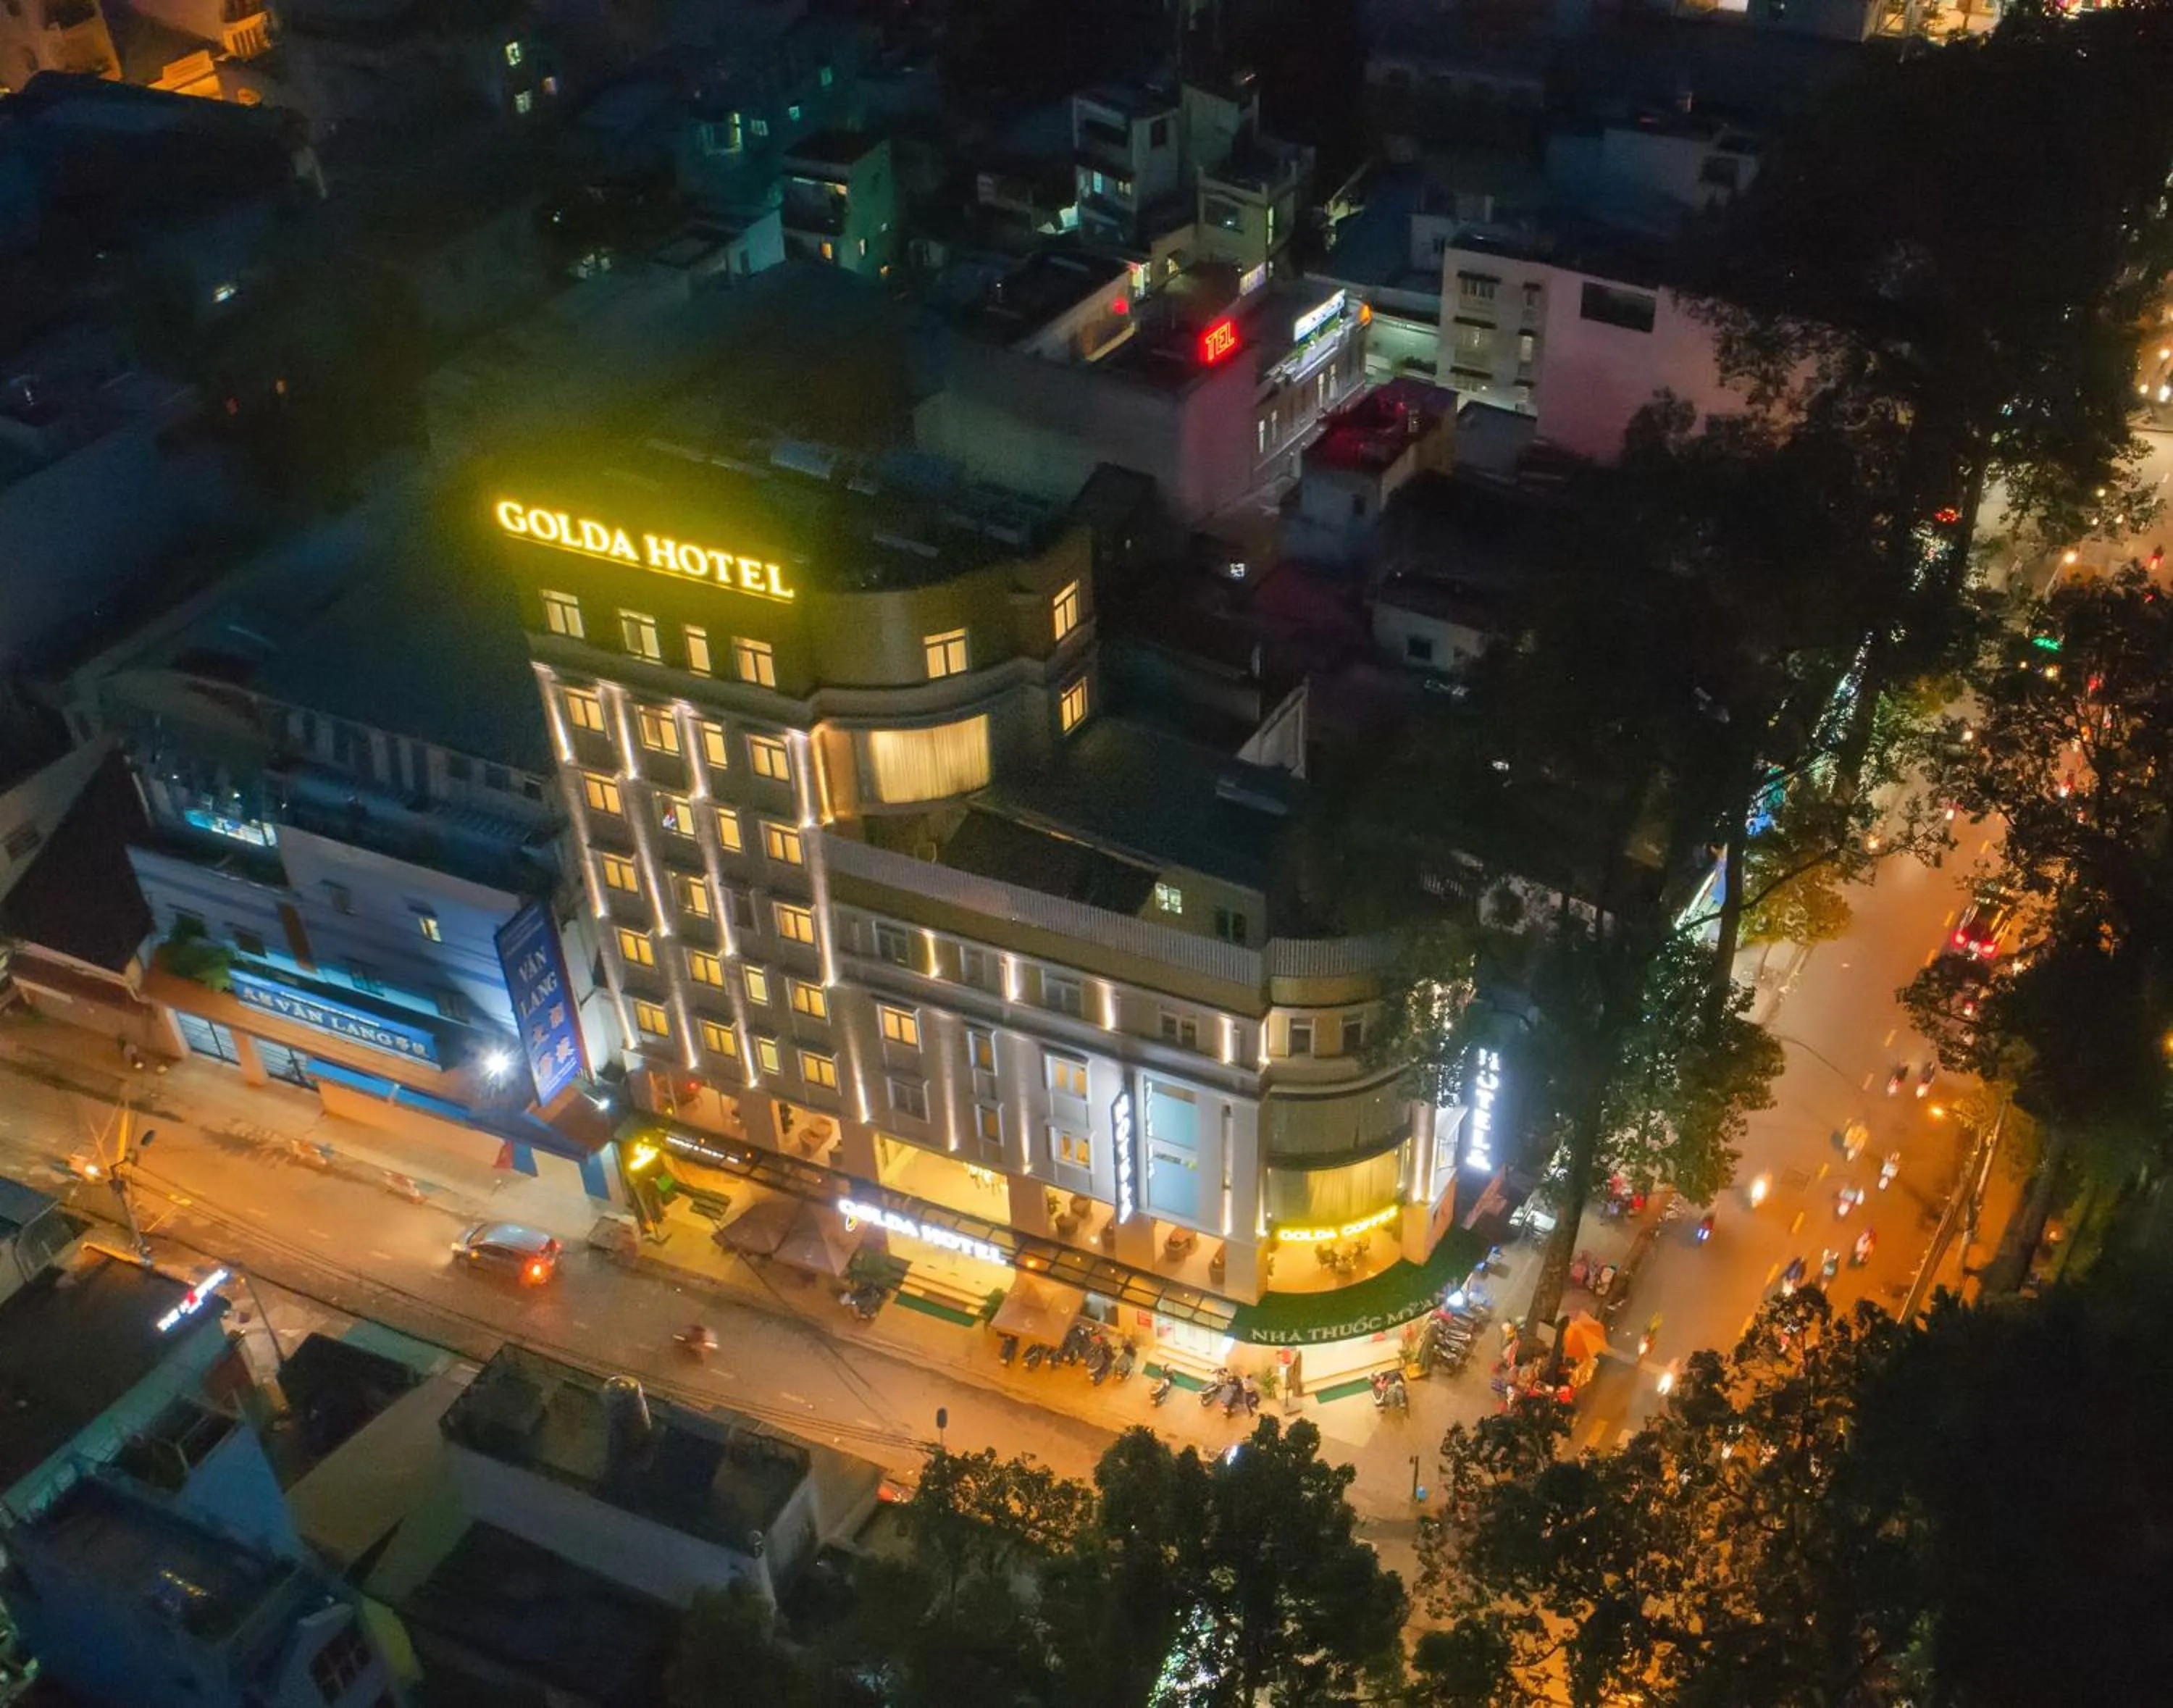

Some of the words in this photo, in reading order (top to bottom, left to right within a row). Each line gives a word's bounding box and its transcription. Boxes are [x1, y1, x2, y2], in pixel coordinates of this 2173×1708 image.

[1205, 321, 1235, 361] TEL
[497, 501, 640, 561] GOLDA
[643, 532, 795, 598] HOTEL
[519, 971, 558, 1020] LANG
[331, 1016, 393, 1046] LANG
[1470, 1047, 1501, 1152] HOTEL
[921, 1224, 1007, 1265] HOTEL
